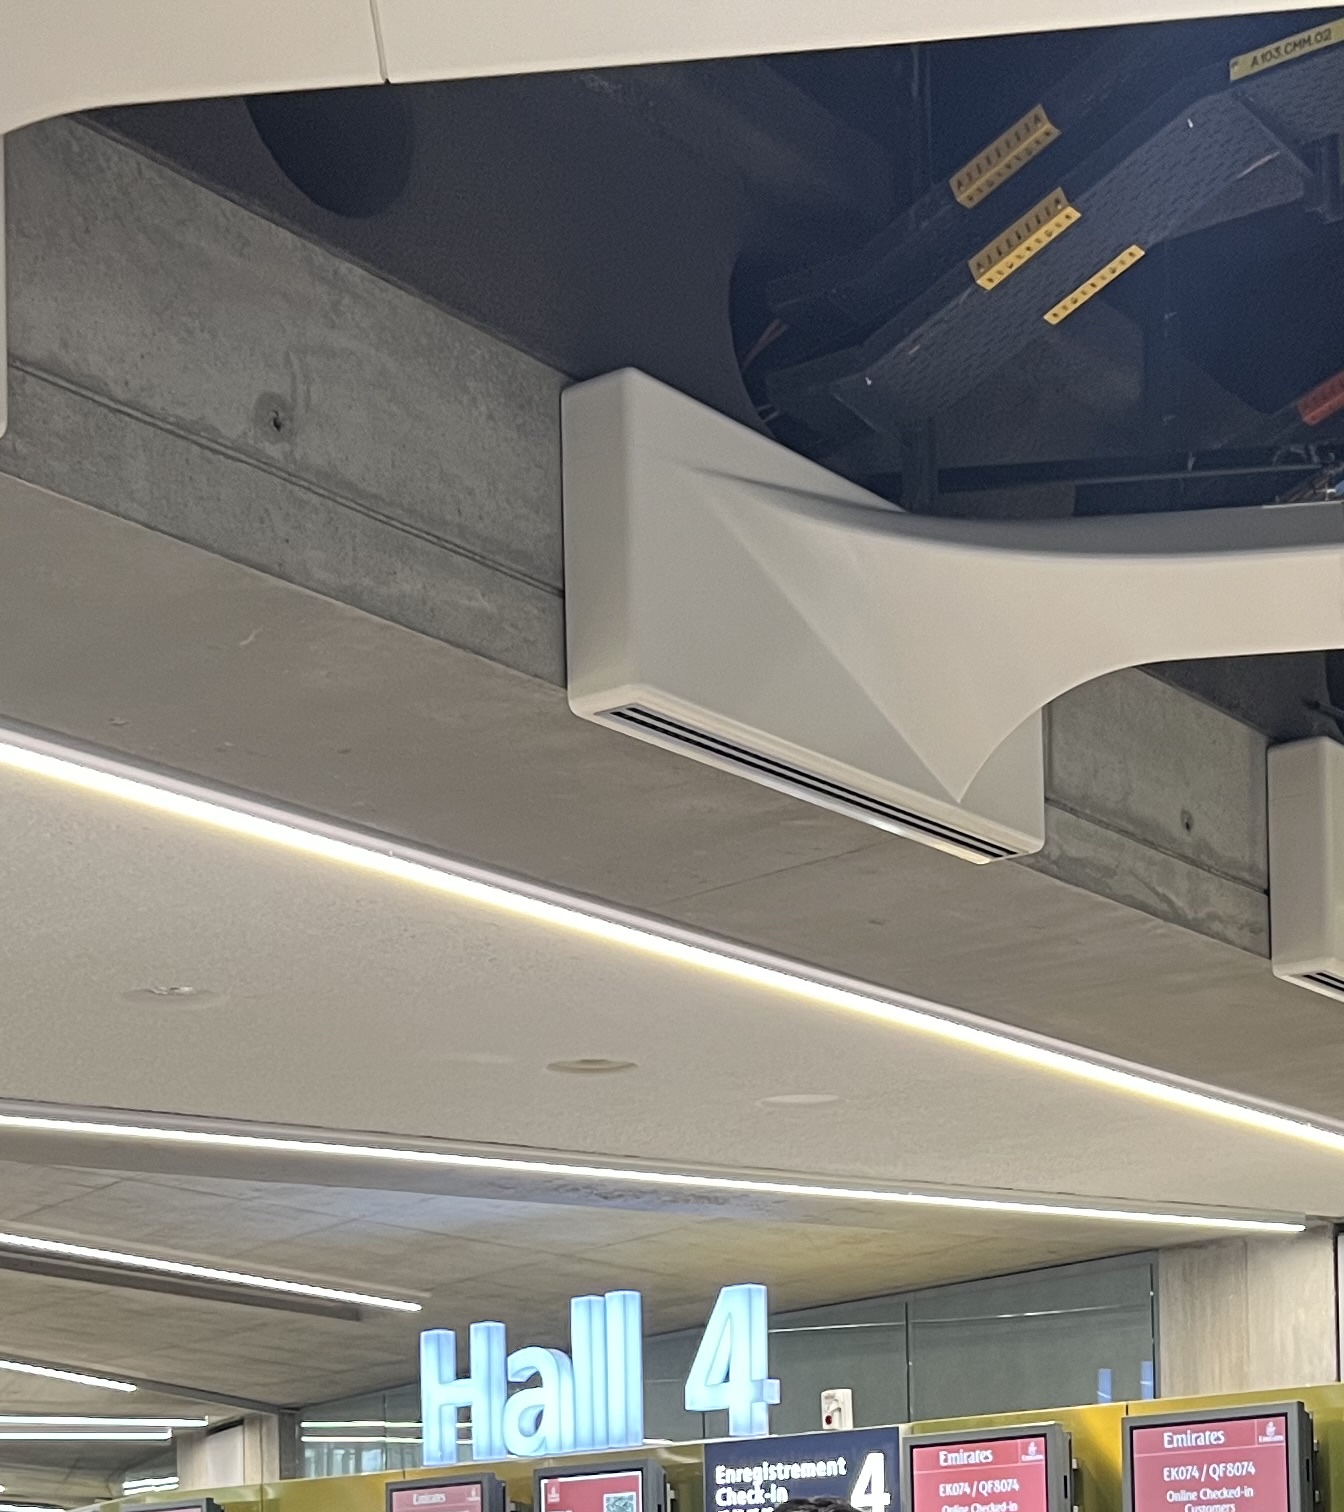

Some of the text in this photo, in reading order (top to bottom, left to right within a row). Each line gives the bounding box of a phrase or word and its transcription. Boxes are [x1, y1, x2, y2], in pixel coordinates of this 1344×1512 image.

[420, 1283, 781, 1467] Hall 4
[1163, 1429, 1225, 1448] Emirates
[938, 1448, 994, 1467] Emirates
[715, 1456, 847, 1485] Enregistrement
[1163, 1466, 1200, 1482] EK074
[1208, 1461, 1256, 1481] QF8074
[715, 1481, 789, 1507] Check-in
[939, 1482, 971, 1497] EK074
[978, 1478, 1020, 1497] QF8074
[1166, 1485, 1254, 1503] Online Checked-in
